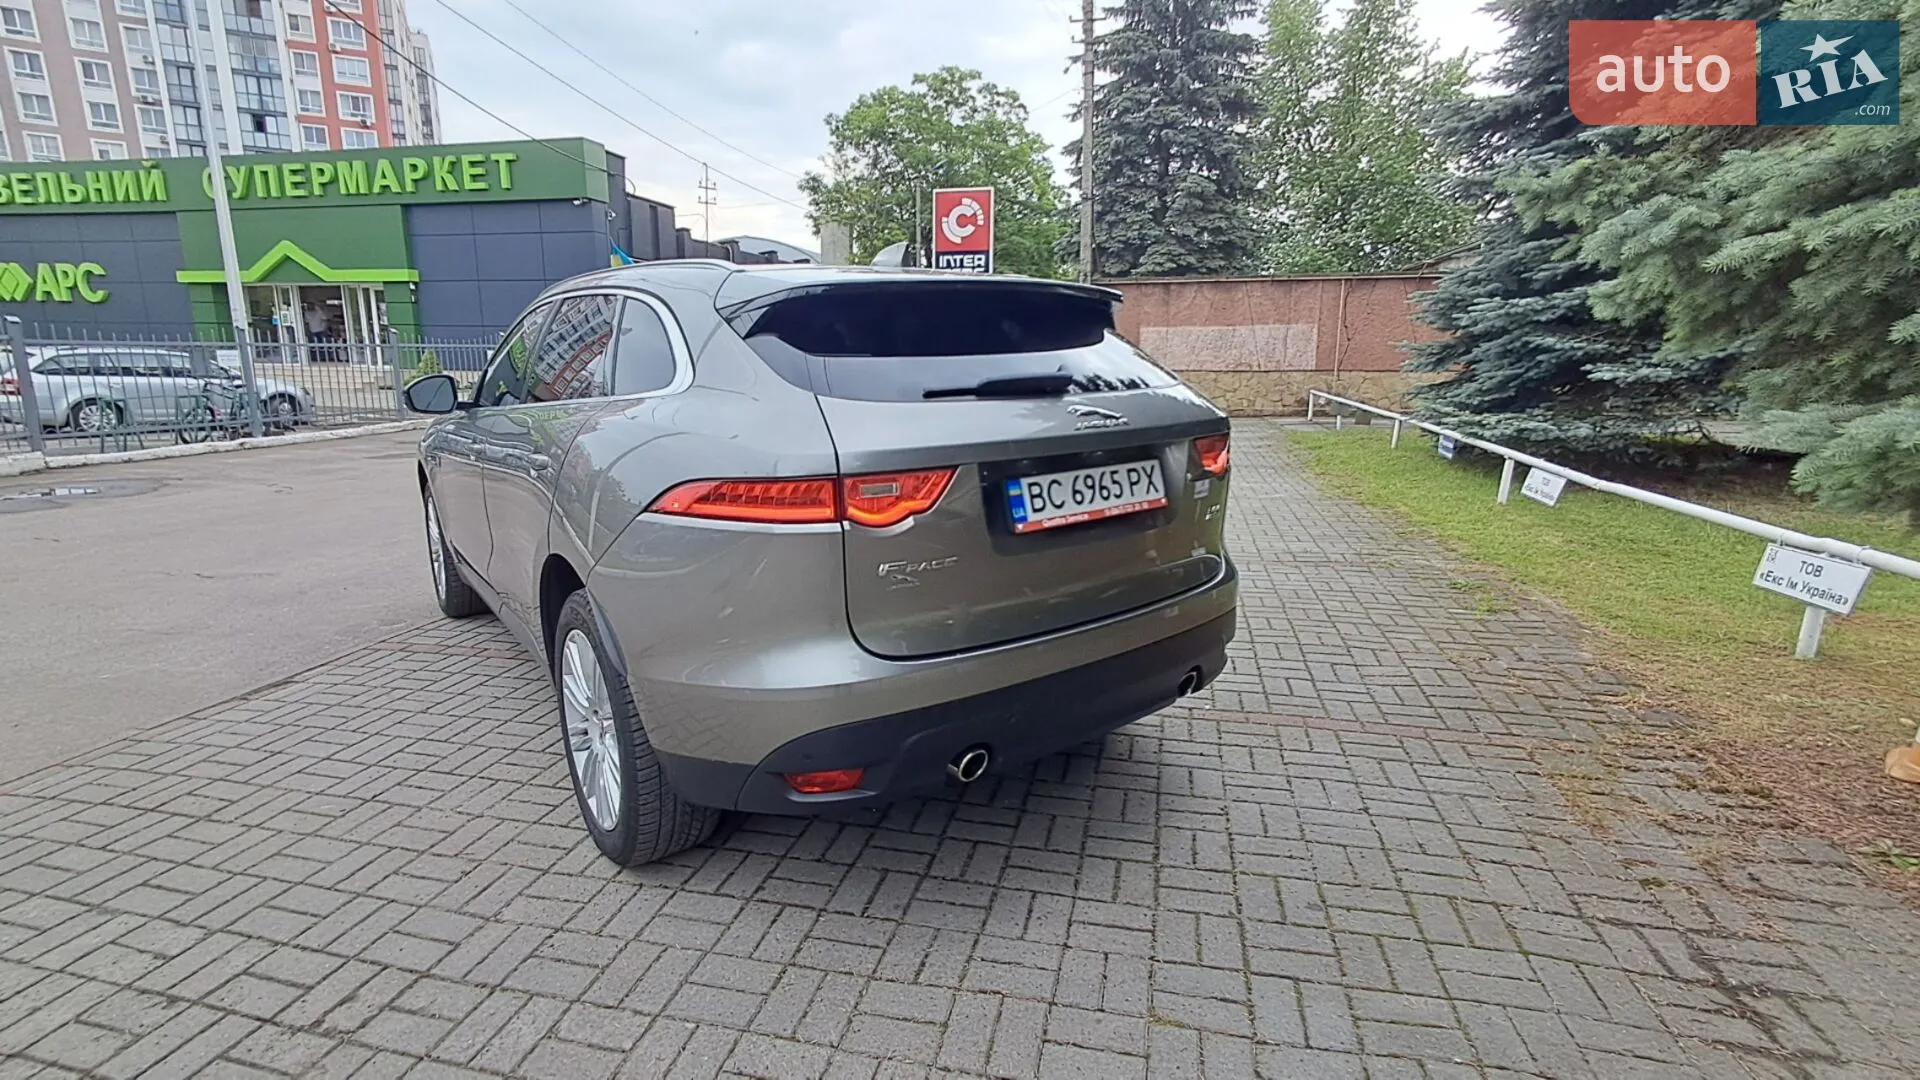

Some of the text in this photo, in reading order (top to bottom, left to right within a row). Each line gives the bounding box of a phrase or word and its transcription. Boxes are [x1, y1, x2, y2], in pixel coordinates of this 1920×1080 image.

[938, 254, 986, 268] INTER
[35, 262, 109, 303] АРС
[1027, 479, 1066, 513] BC
[1072, 470, 1124, 505] 6965
[1126, 464, 1160, 497] PX
[1012, 507, 1026, 518] UA
[1800, 560, 1824, 578] ТОВ
[1759, 570, 1785, 586] «Екс
[1799, 580, 1849, 606] Україна»
